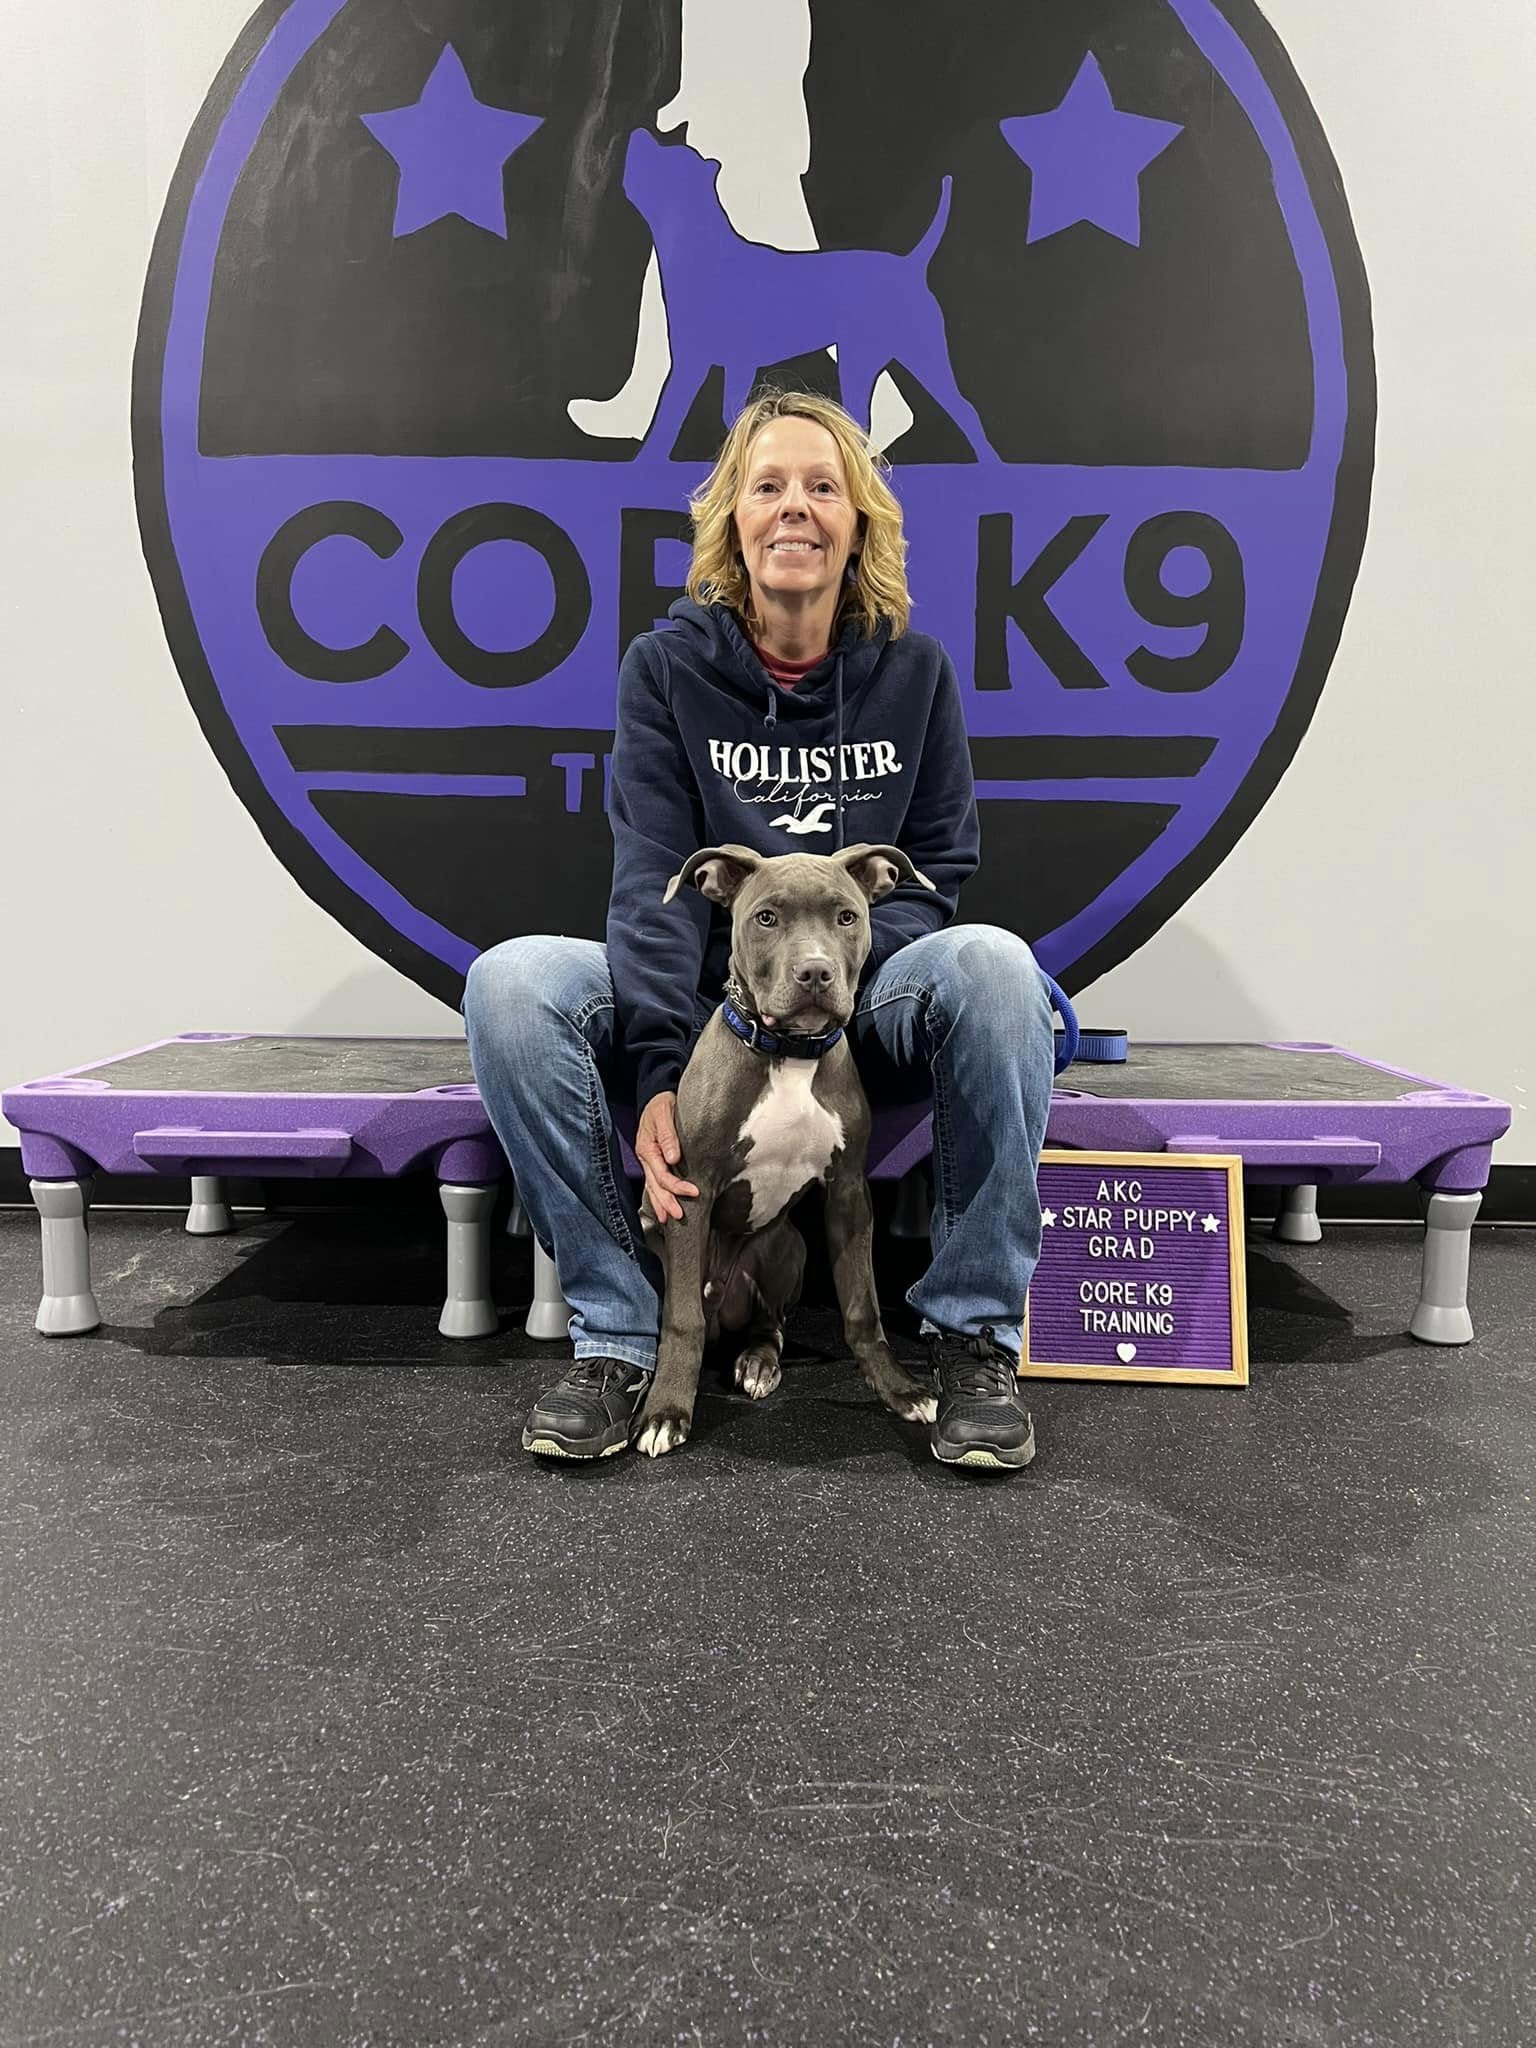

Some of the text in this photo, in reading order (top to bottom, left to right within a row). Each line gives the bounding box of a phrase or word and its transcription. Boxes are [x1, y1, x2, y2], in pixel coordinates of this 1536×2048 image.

[974, 510, 1246, 693] K9
[707, 739, 902, 783] HOLLISTER
[733, 772, 883, 818] California
[1096, 1180, 1142, 1203] AKC
[1062, 1206, 1197, 1232] STAR PUPPY
[1089, 1236, 1155, 1259] GRAD
[1079, 1281, 1173, 1306] CORE K9
[1079, 1309, 1174, 1335] TRAINING
